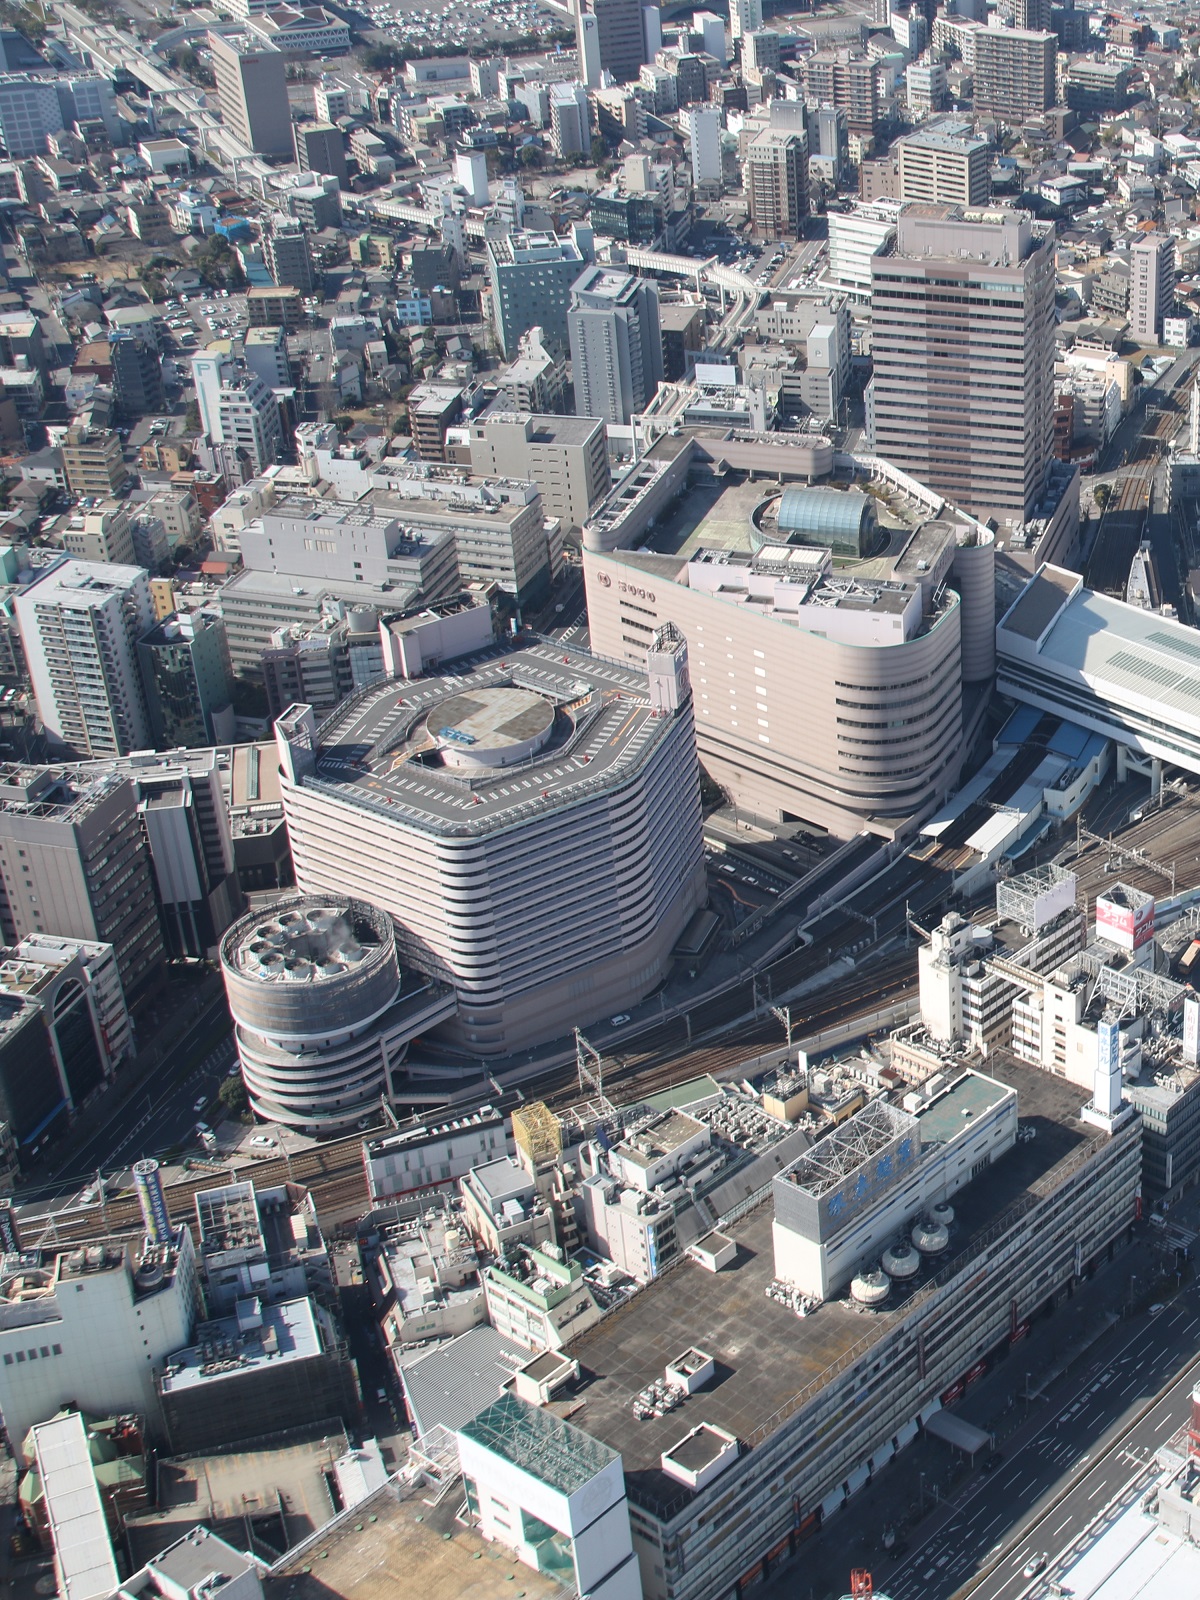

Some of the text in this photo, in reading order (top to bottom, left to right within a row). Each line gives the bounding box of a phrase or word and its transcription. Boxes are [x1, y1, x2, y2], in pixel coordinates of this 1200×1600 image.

[1103, 909, 1128, 927] アコム
[1136, 919, 1154, 939] アコム
